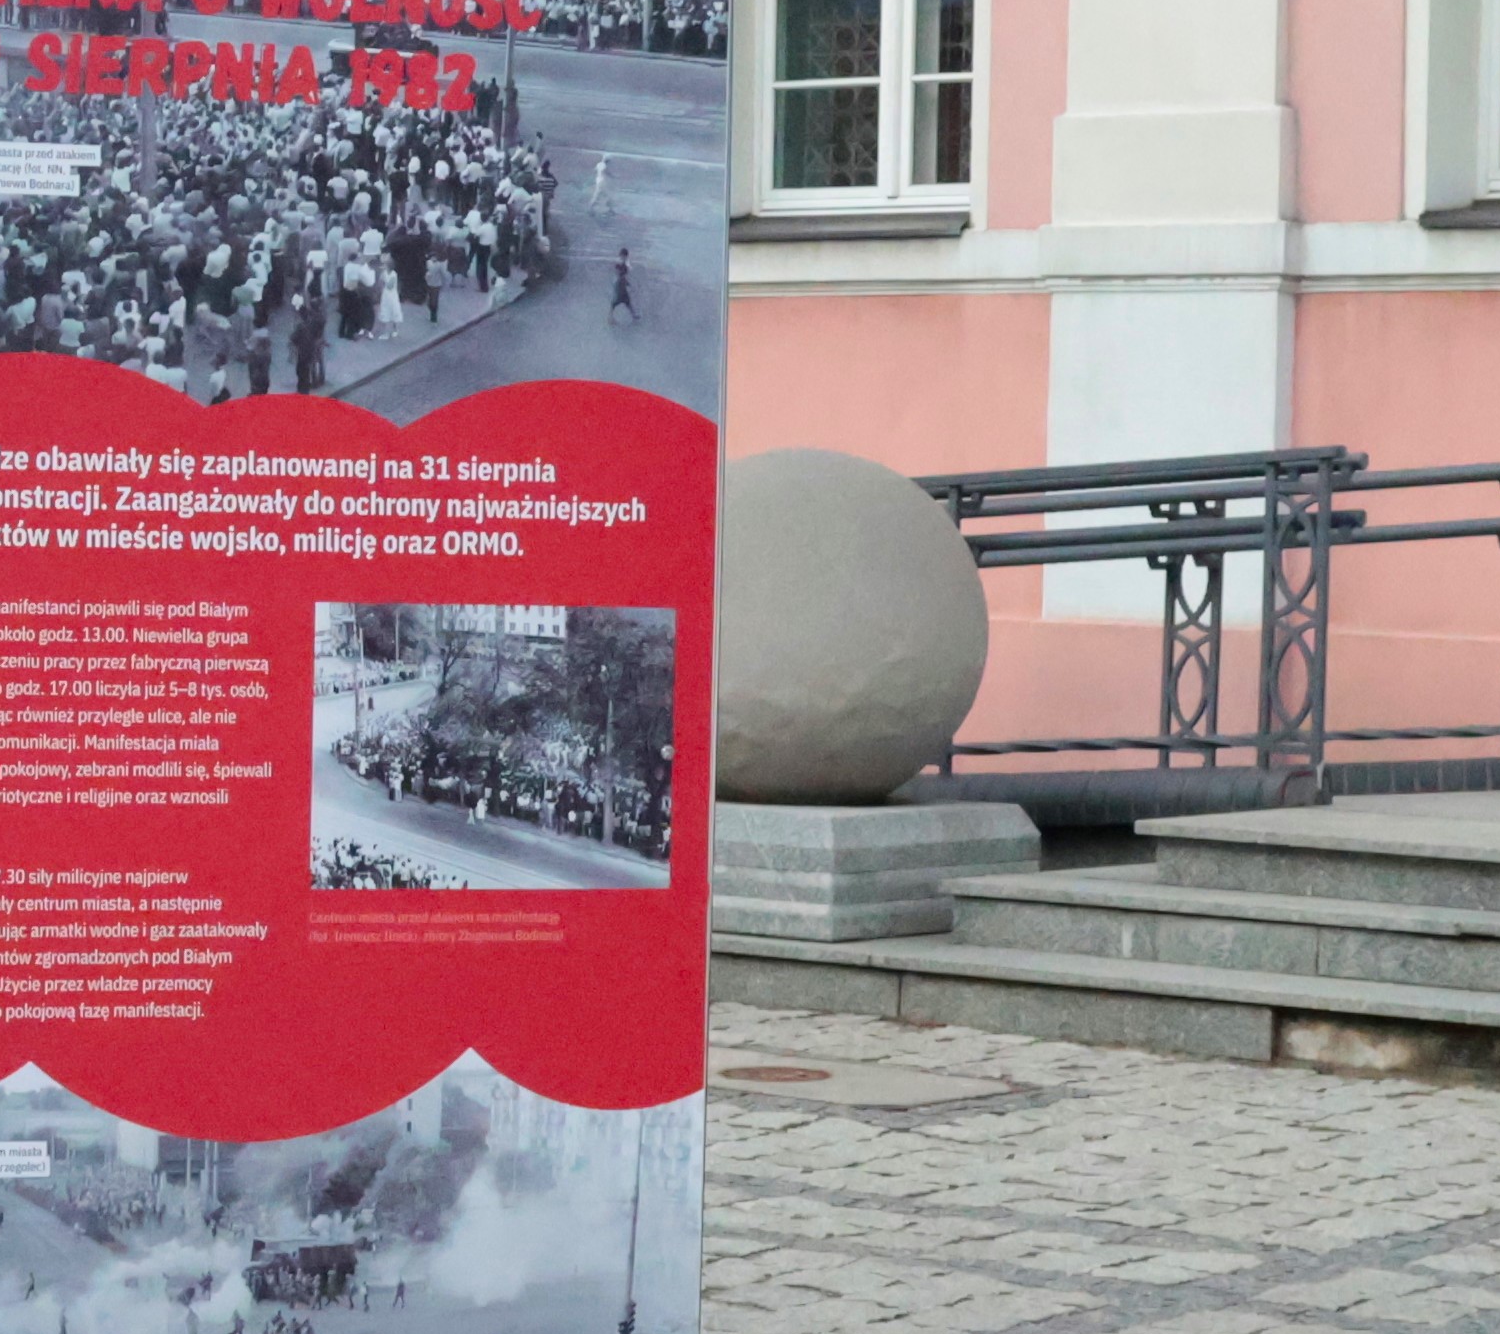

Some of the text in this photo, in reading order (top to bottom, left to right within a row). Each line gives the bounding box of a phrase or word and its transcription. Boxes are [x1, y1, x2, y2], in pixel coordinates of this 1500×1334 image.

[25, 33, 320, 104] SIERPNIA
[348, 48, 476, 111] 1982
[36, 446, 152, 479] obawiały
[159, 448, 195, 480] się
[202, 450, 376, 484] zaplanowanej
[384, 460, 413, 479] na
[420, 456, 450, 480] 31
[458, 456, 555, 487] sierpnia
[116, 487, 298, 520] Zaangażowały
[304, 490, 335, 515] do
[341, 491, 440, 523] ochrony
[447, 493, 645, 526] najważniejszych
[57, 529, 79, 547] w
[86, 522, 183, 549] mieście
[190, 525, 286, 556] wojsko,
[294, 527, 376, 559] milicję
[383, 535, 436, 554] oraz
[443, 531, 523, 556] ORMO.
[84, 600, 140, 619] pojawili
[144, 601, 165, 620] się
[168, 601, 195, 619] pod
[199, 602, 248, 621] Białym
